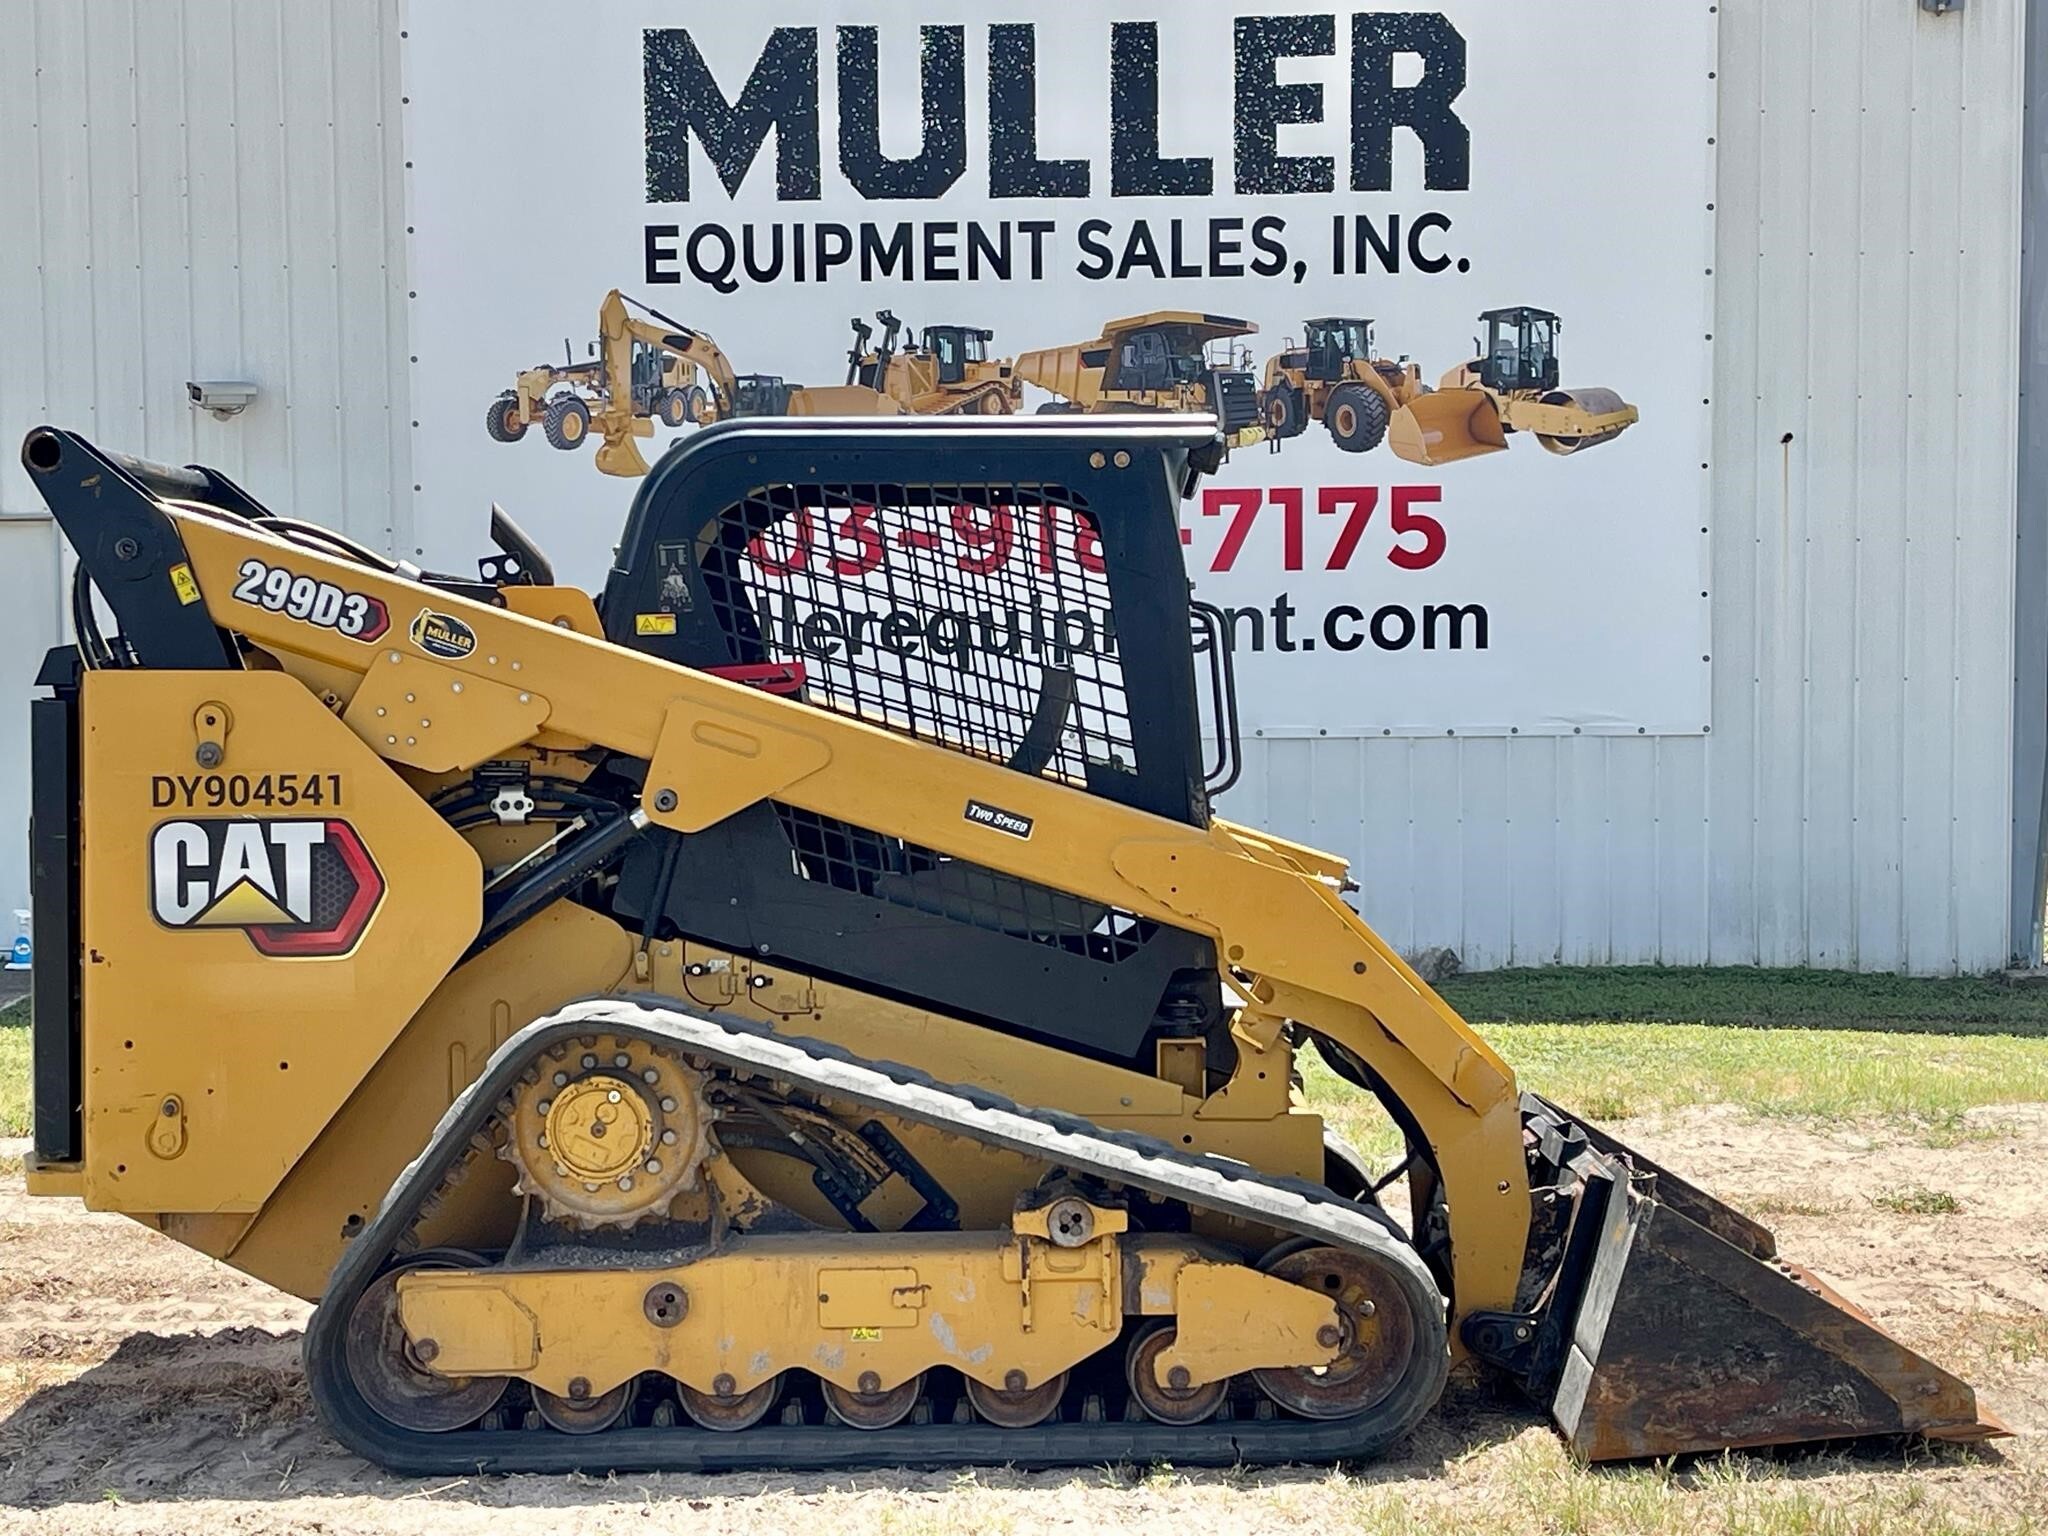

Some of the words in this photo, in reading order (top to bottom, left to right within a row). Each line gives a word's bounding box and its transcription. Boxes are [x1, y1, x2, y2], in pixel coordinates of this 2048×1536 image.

[642, 11, 1470, 202] MULLER
[644, 221, 1055, 292] EQUIPMENT
[1077, 216, 1307, 283] SALES,
[1332, 212, 1471, 276] INC.
[234, 560, 369, 635] 299D3
[427, 626, 472, 648] MULLER
[152, 774, 341, 807] DY904541
[154, 821, 325, 925] CAT
